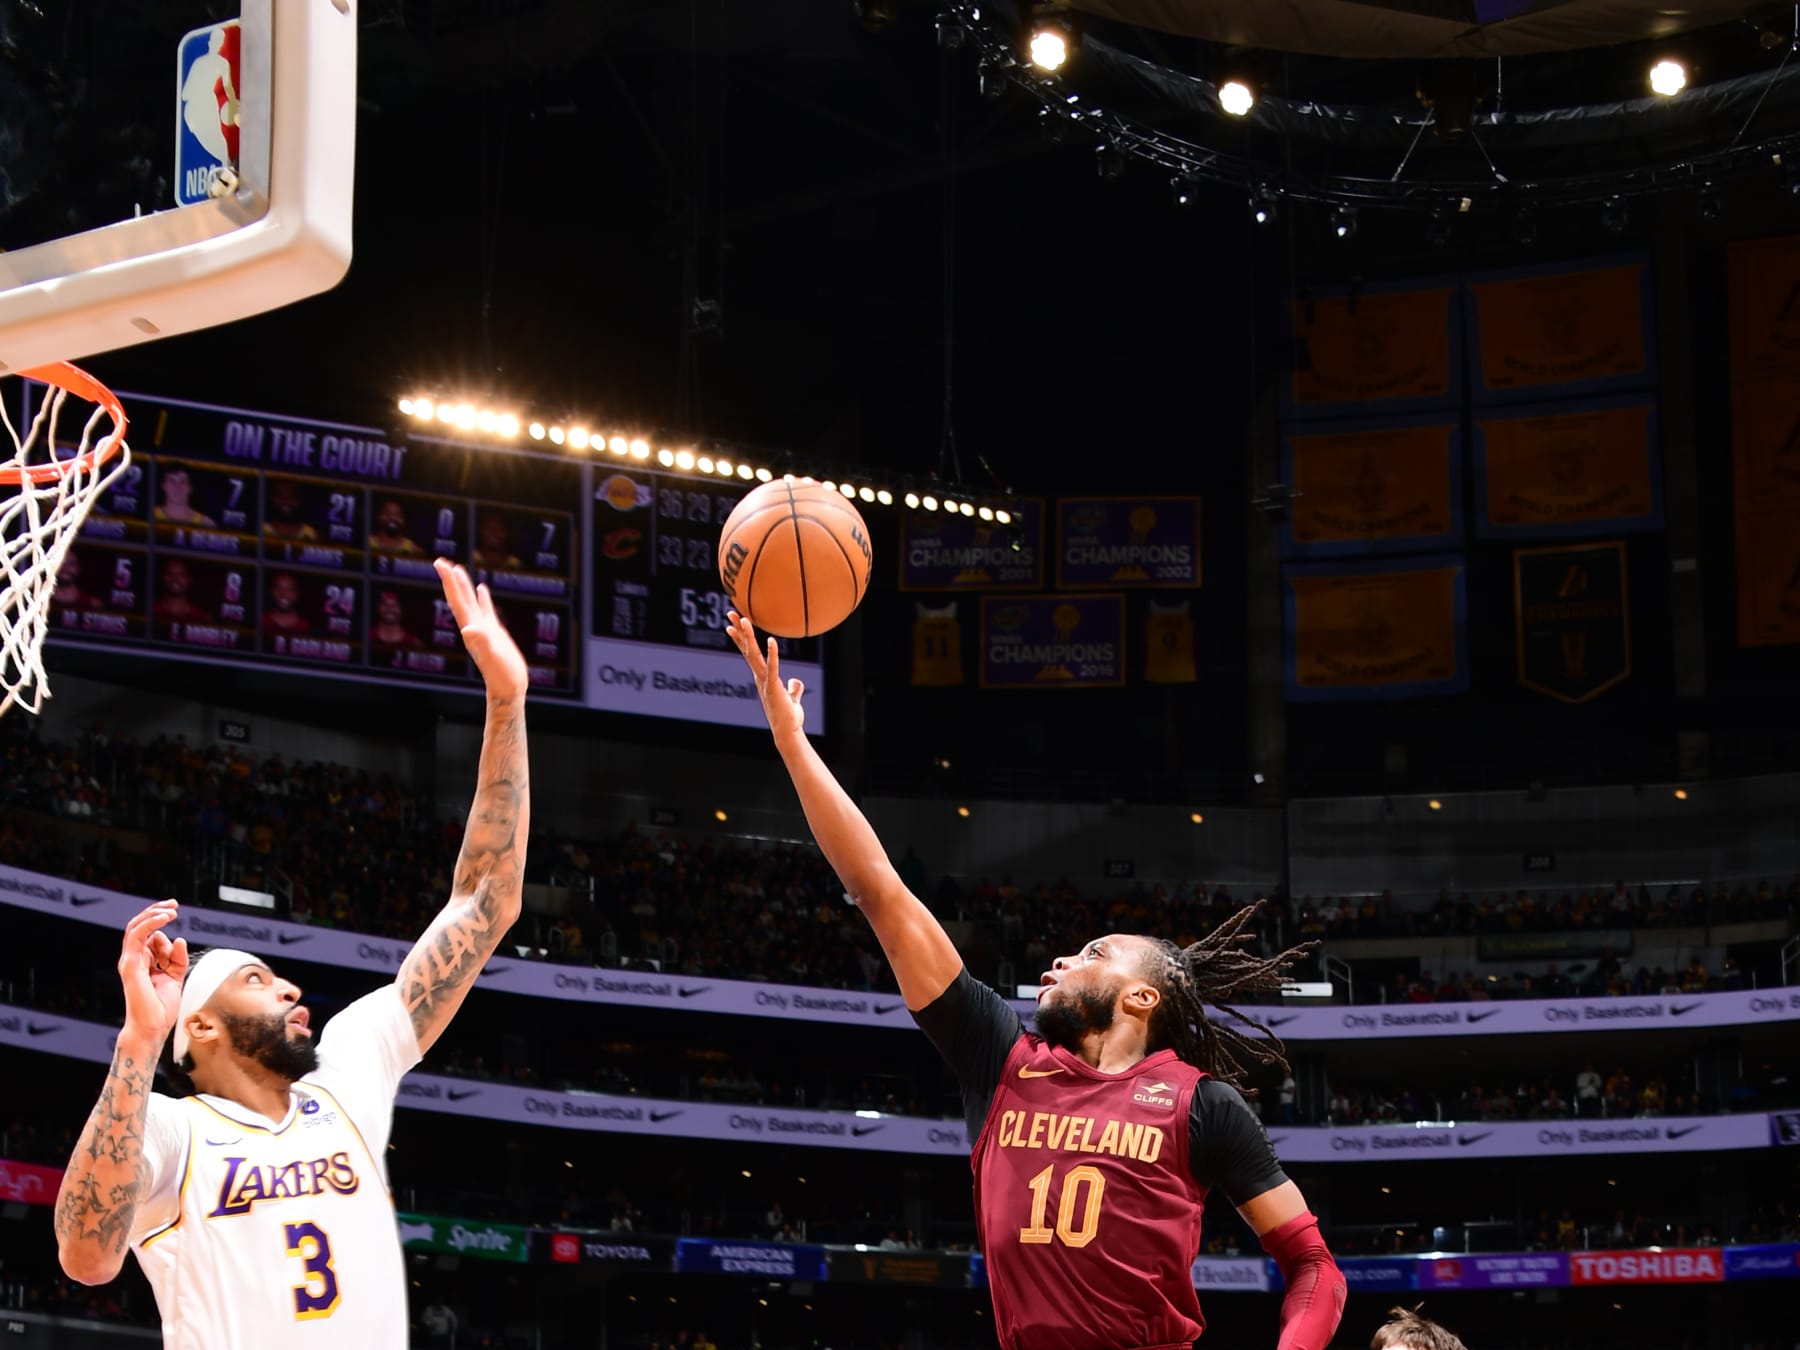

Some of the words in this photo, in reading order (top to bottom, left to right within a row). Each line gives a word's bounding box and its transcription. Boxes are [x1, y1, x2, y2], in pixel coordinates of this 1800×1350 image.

[226, 421, 263, 459] ON
[269, 427, 315, 467] THE
[320, 434, 406, 479] COURT
[229, 478, 243, 507] 7
[328, 493, 355, 523] 21
[542, 522, 556, 549] 7
[908, 547, 1034, 568] CHAMPIONS
[1066, 544, 1192, 566] CHAMPIONS
[115, 558, 132, 588] 5
[1154, 566, 1193, 580] 2002
[989, 642, 1115, 665] CHAMPIONS
[599, 664, 647, 691] Only
[1079, 663, 1115, 679] 2016
[189, 915, 272, 941] Basketball
[357, 943, 392, 964] Only
[555, 973, 589, 993] Only
[594, 977, 671, 997] Basketball
[755, 991, 788, 1010] Only
[792, 995, 867, 1014] Basketball
[1544, 1006, 1580, 1023] Only
[1584, 1003, 1664, 1021] Basketball
[1750, 997, 1786, 1014] Only
[1343, 1013, 1378, 1030] Only
[1381, 1010, 1459, 1027] Basketball
[524, 1097, 558, 1118] Only
[562, 1101, 643, 1122] Basketball
[1133, 1093, 1173, 1106] CLIFFS
[728, 1114, 763, 1133] Only
[767, 1116, 846, 1137] Basketball
[999, 1110, 1164, 1163] CLEVELAND
[1537, 1129, 1573, 1146] Only
[1579, 1126, 1659, 1144] Basketball
[927, 1129, 962, 1147] Only
[1331, 1136, 1367, 1153] Only
[1371, 1132, 1452, 1150] Basketball
[205, 1151, 360, 1221] LAKERS
[1019, 1163, 1106, 1248] 10
[448, 1225, 512, 1254] Sprite
[584, 1243, 651, 1260] TOYOTA
[711, 1246, 793, 1262] AMERICAN
[282, 1219, 342, 1322] 3
[721, 1259, 795, 1275] EXPRESS
[1577, 1255, 1717, 1280] TOSHIBA
